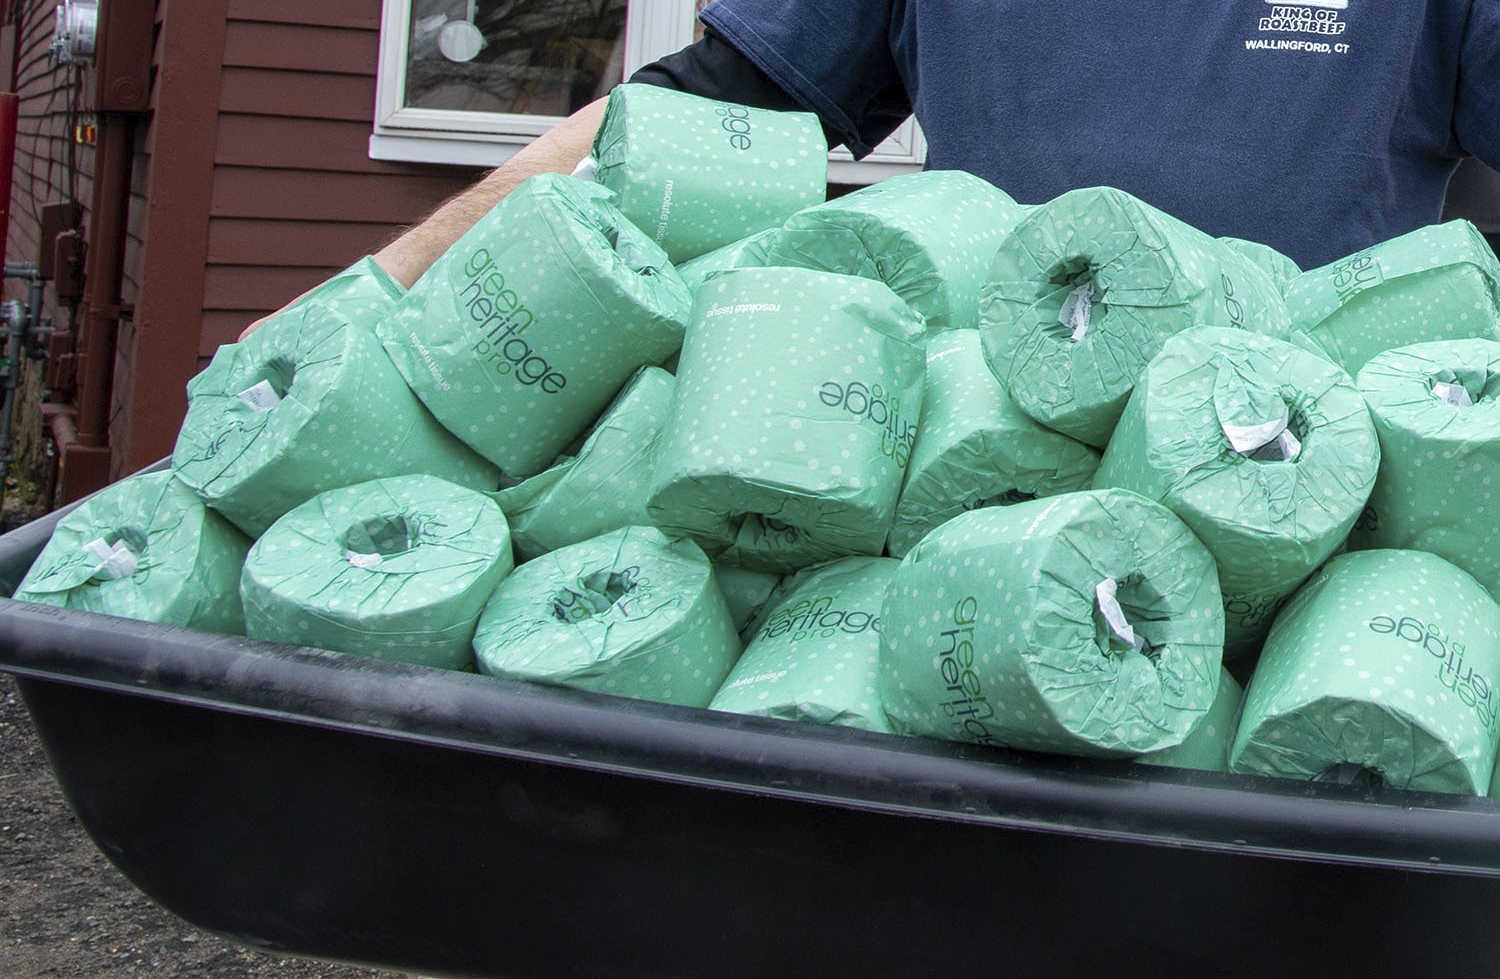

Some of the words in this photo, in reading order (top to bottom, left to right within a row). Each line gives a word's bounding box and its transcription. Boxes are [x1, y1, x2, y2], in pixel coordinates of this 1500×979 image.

[1258, 18, 1345, 35] ROASTBEEF
[1271, 6, 1312, 21] KING
[1316, 8, 1338, 22] OF
[1245, 39, 1332, 54] WALLINGFORD,
[1334, 42, 1350, 54] CT
[464, 248, 535, 335] green
[460, 276, 567, 395] heritage
[470, 338, 513, 376] pro
[818, 381, 918, 449] eritage
[789, 626, 836, 645] pro
[953, 596, 995, 721] green
